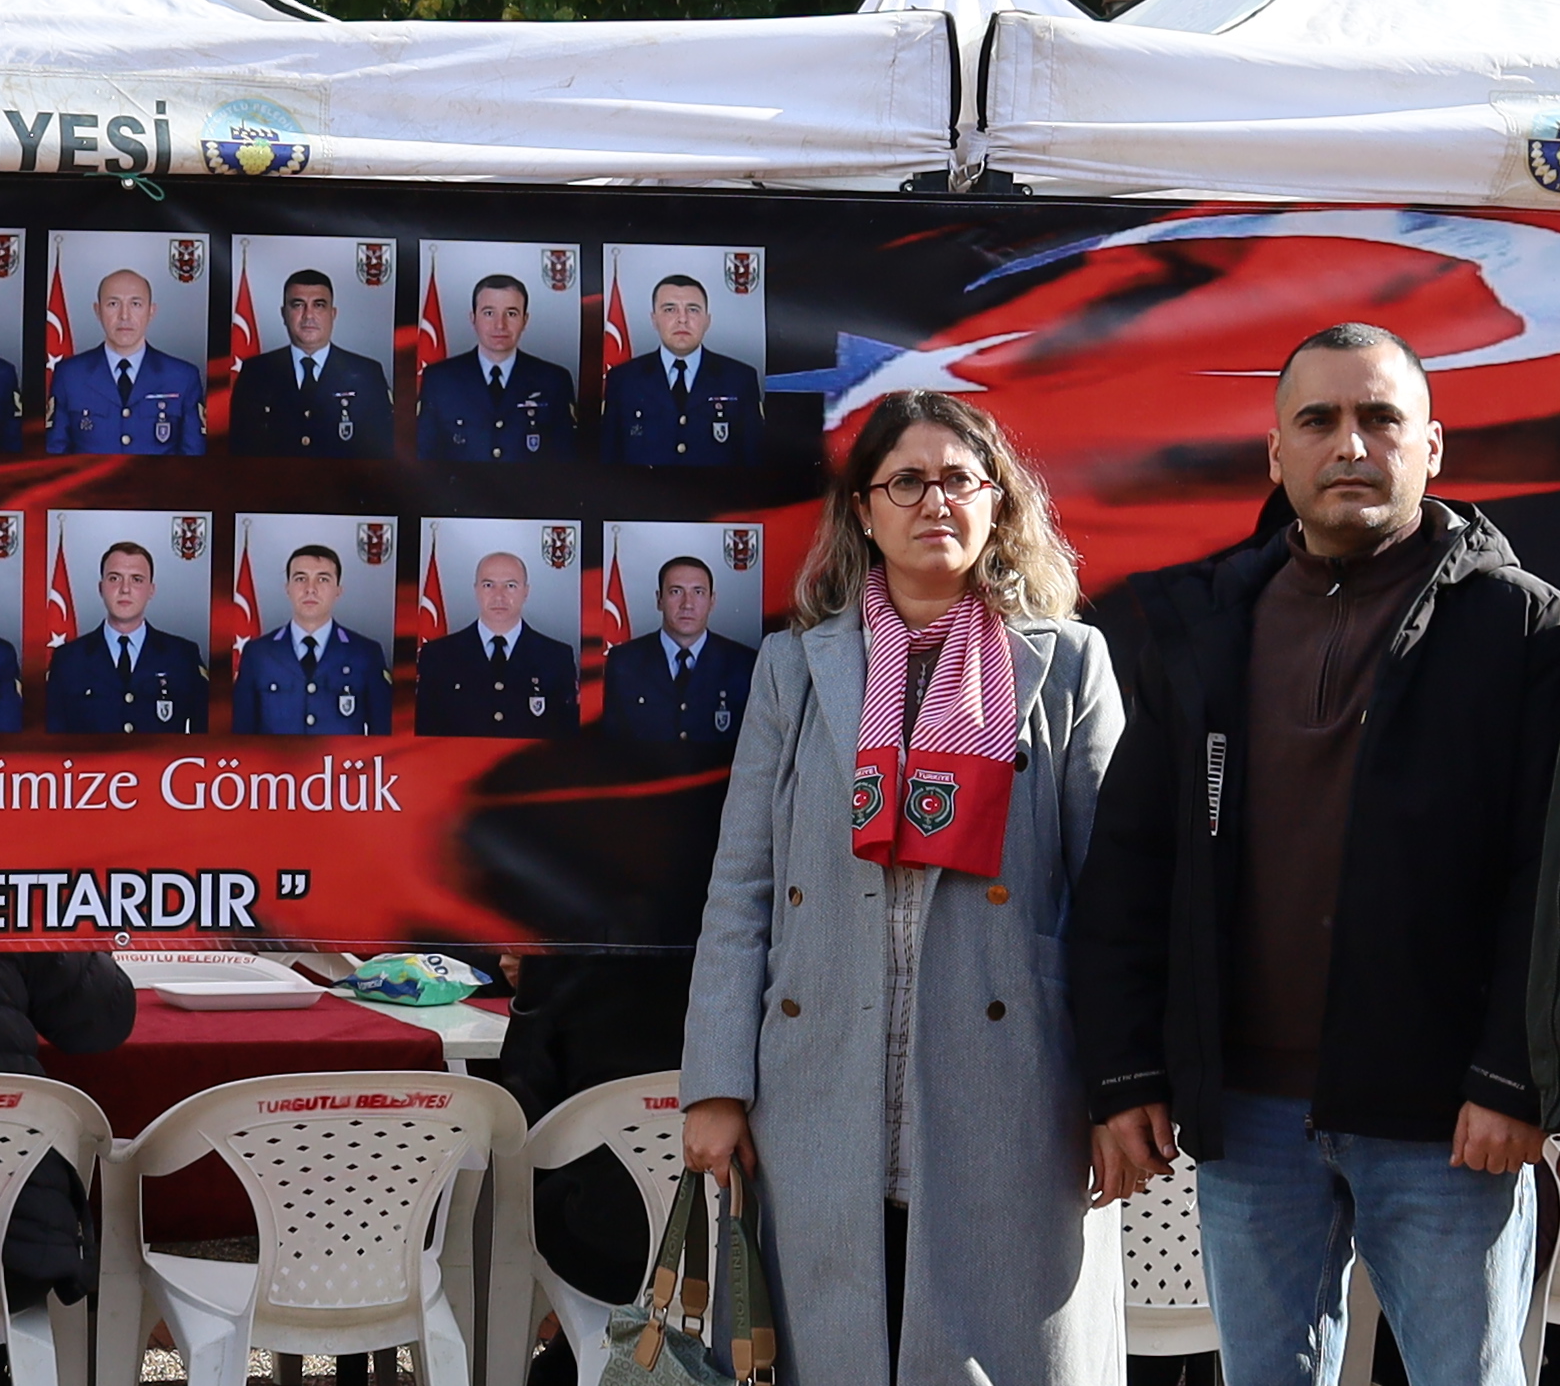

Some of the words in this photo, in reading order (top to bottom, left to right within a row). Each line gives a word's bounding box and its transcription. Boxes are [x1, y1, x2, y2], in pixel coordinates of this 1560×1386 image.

[159, 754, 403, 813] Gömdük
[256, 1095, 351, 1115] TURGUTLU
[355, 1093, 453, 1112] BELEDİYESİ
